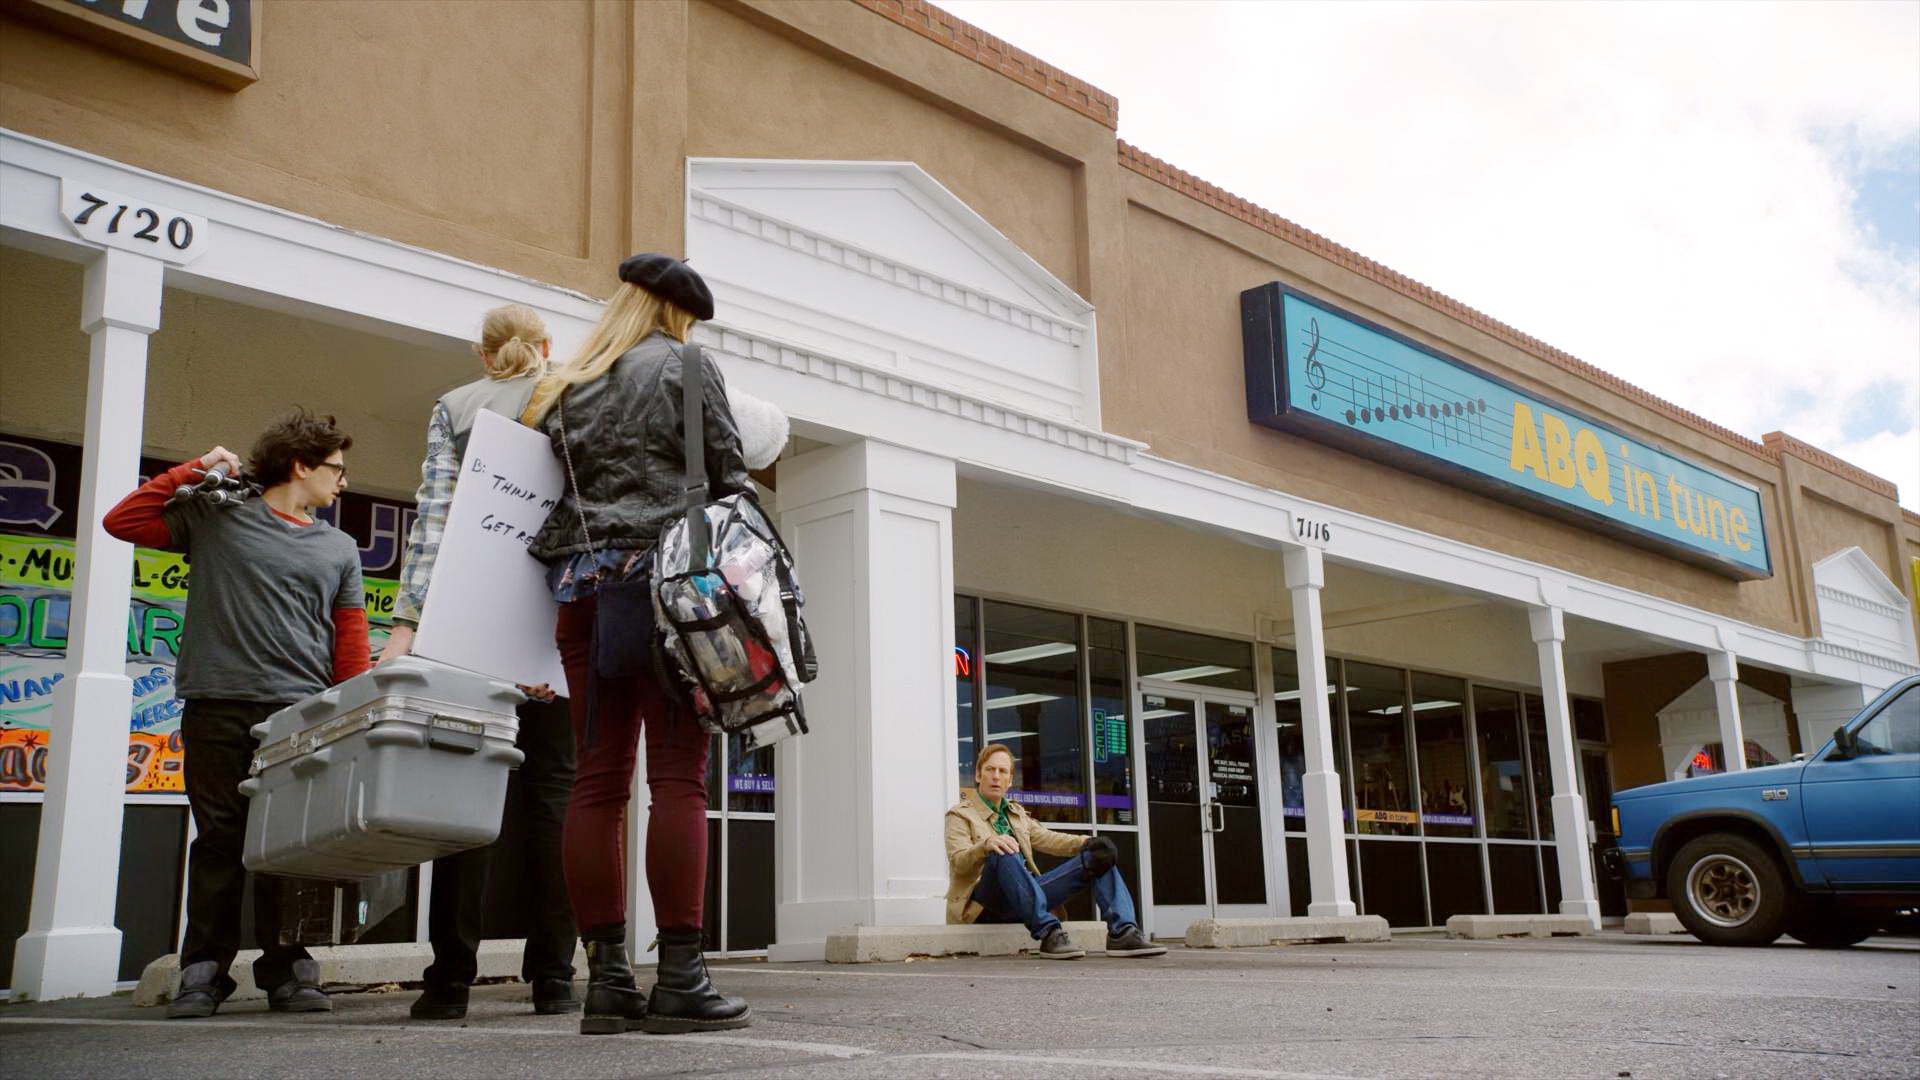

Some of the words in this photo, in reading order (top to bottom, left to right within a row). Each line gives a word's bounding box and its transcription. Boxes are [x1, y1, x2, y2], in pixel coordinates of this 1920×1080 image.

[74, 192, 194, 250] 7120
[1510, 400, 1614, 507] ABQ
[1620, 444, 1661, 521] in
[1666, 473, 1751, 552] tune
[480, 514, 515, 536] GET
[1296, 517, 1330, 542] 7116
[743, 779, 756, 791] BUY
